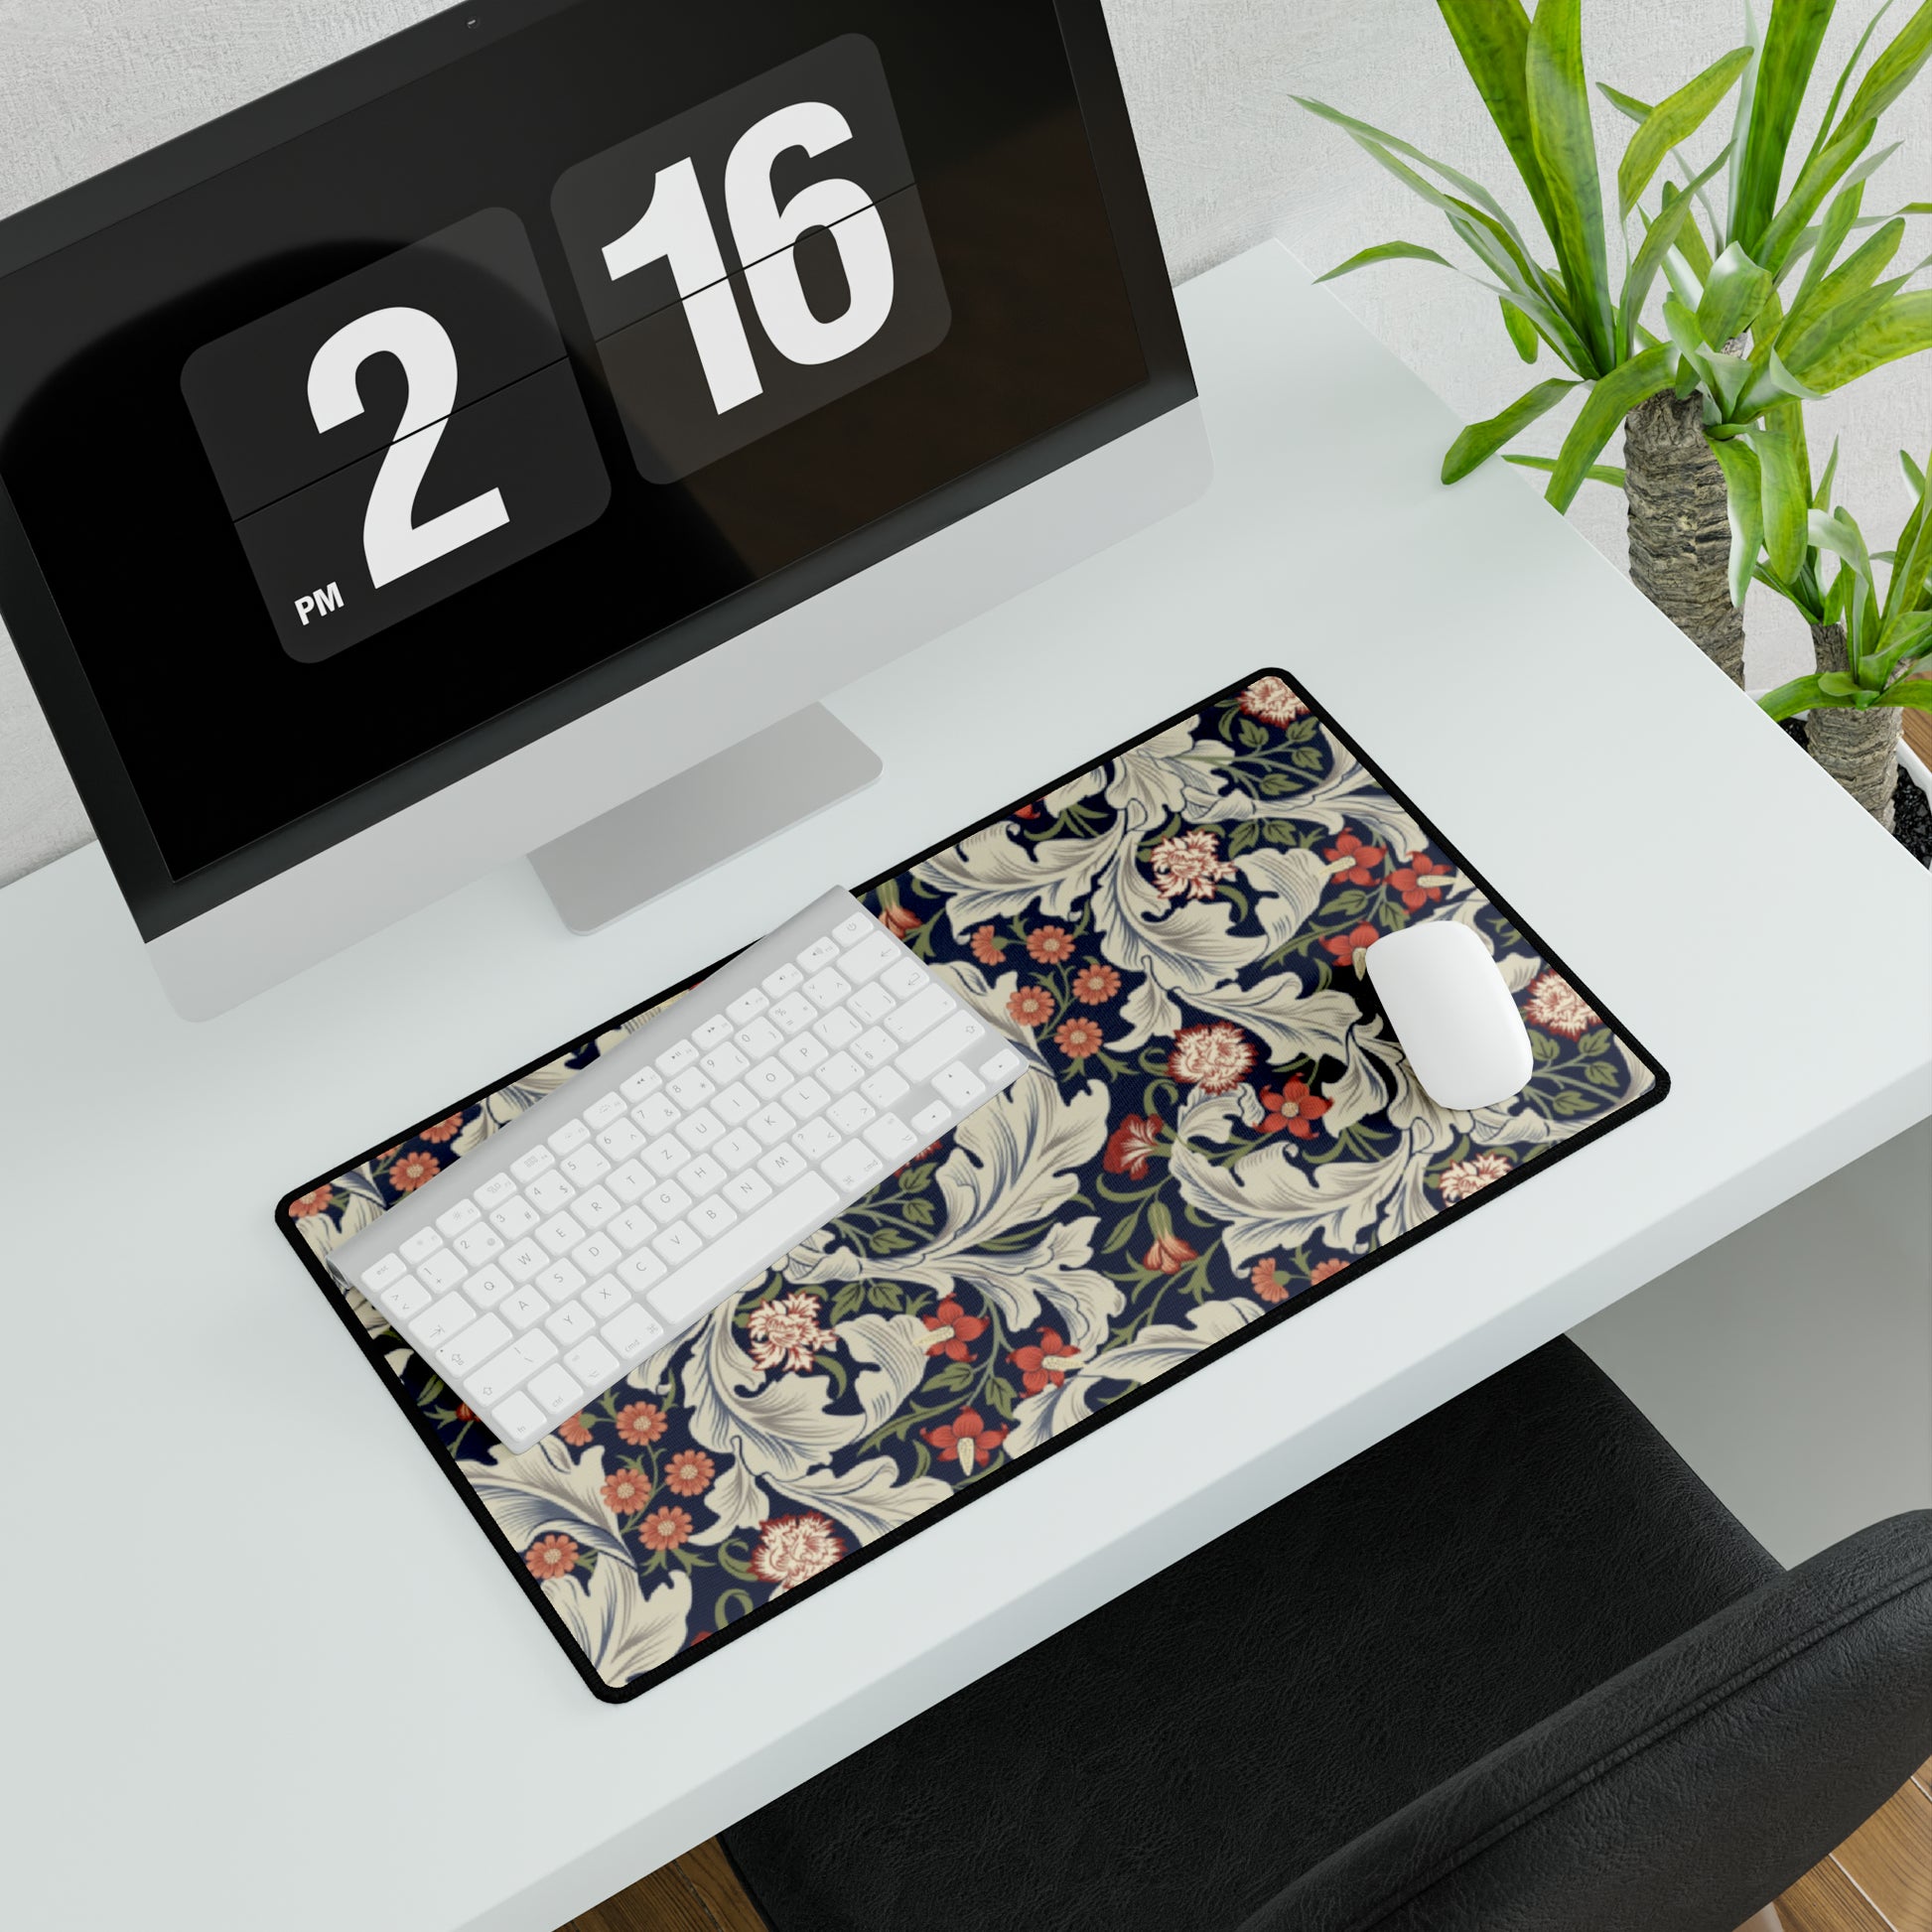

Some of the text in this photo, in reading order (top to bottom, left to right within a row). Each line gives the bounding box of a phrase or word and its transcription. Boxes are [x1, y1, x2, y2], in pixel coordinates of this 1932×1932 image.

[307, 101, 895, 590] 2 16
[294, 581, 345, 626] PM
[741, 1033, 752, 1043] 0
[798, 1046, 808, 1057] P
[705, 1058, 716, 1069] 9
[764, 1071, 777, 1083] O
[671, 1083, 683, 1094] 8
[797, 1089, 811, 1101] L
[635, 1109, 646, 1120] 7
[762, 1114, 778, 1127] K
[694, 1122, 708, 1135] U
[603, 1136, 613, 1146] 6
[729, 1140, 741, 1153] J
[659, 1148, 674, 1161] Z
[566, 1160, 578, 1172] 5
[773, 1156, 790, 1169] M
[693, 1167, 708, 1179] H
[624, 1174, 636, 1186] T
[533, 1185, 543, 1196] 4
[739, 1180, 756, 1195] N
[659, 1191, 672, 1204] G
[590, 1200, 604, 1212] R
[495, 1212, 506, 1224] 3
[705, 1208, 718, 1220] B
[623, 1218, 633, 1231] F
[555, 1226, 567, 1239] E
[459, 1239, 472, 1250] 2
[668, 1234, 682, 1245] V
[587, 1246, 601, 1258] D
[516, 1251, 532, 1266] W
[422, 1267, 433, 1277] 1
[635, 1261, 647, 1272] C
[552, 1272, 565, 1284] S
[483, 1281, 497, 1292] Q
[598, 1287, 613, 1301] X
[517, 1300, 530, 1311] A
[561, 1313, 575, 1326] Y
